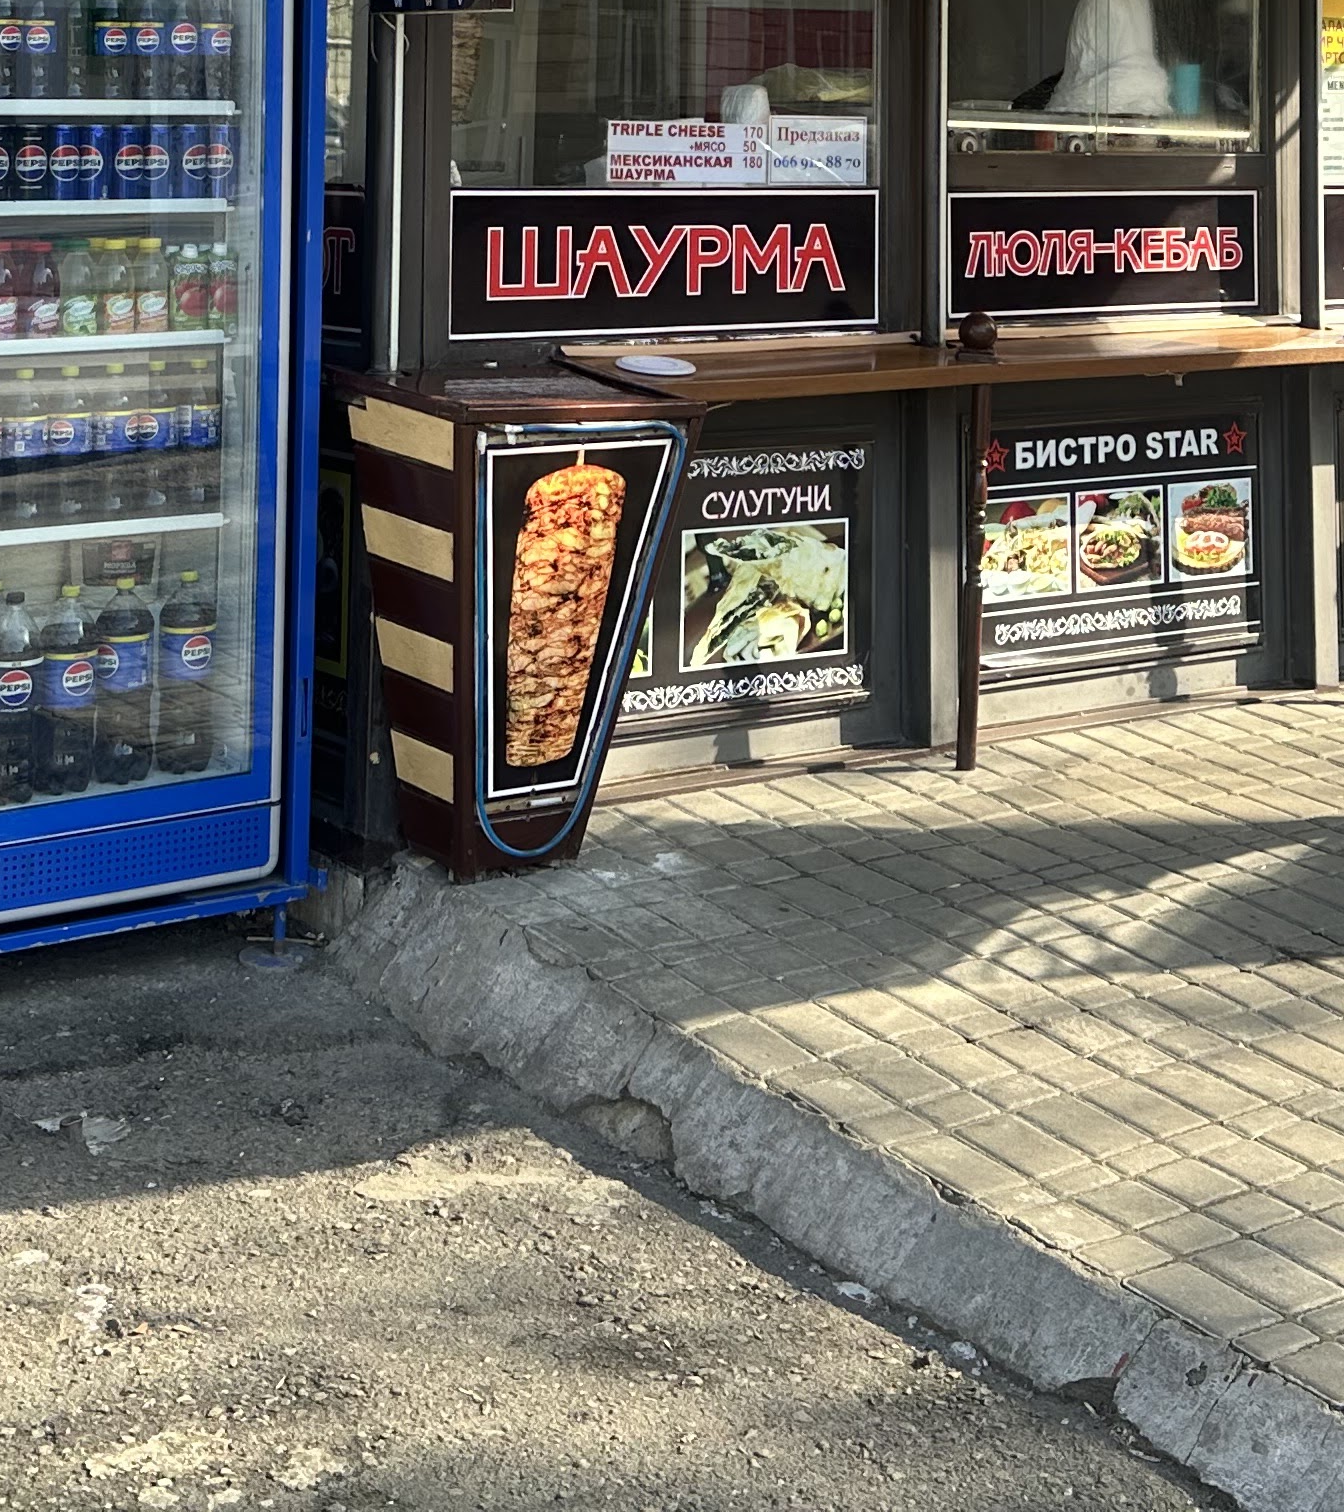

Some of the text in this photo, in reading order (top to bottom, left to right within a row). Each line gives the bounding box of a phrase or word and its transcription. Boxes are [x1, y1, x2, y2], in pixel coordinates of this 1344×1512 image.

[1321, 36, 1333, 47] ИР
[610, 123, 763, 139] TRIPLE CHEESE 170
[777, 126, 860, 145] Предзаказ
[689, 141, 756, 153] +МЯСО 50
[17, 159, 47, 168] PEPSI
[80, 159, 101, 168] EPSI
[610, 155, 762, 169] МЕКСИКАНСКАЯ 180
[773, 156, 798, 169] 066
[826, 156, 842, 169] 88
[845, 158, 861, 170] 70
[610, 168, 676, 181] ШАУРМА
[964, 227, 1244, 279] ЛЮЛЯ-КЕБАБ
[486, 223, 846, 301] ШАУРМА
[1015, 427, 1219, 470] БИСТРО STAR
[701, 484, 831, 520] СУЛУГУНИ
[184, 648, 211, 658] PEPSI
[65, 674, 93, 684] PEPSI
[0, 682, 31, 691] PEPSI
